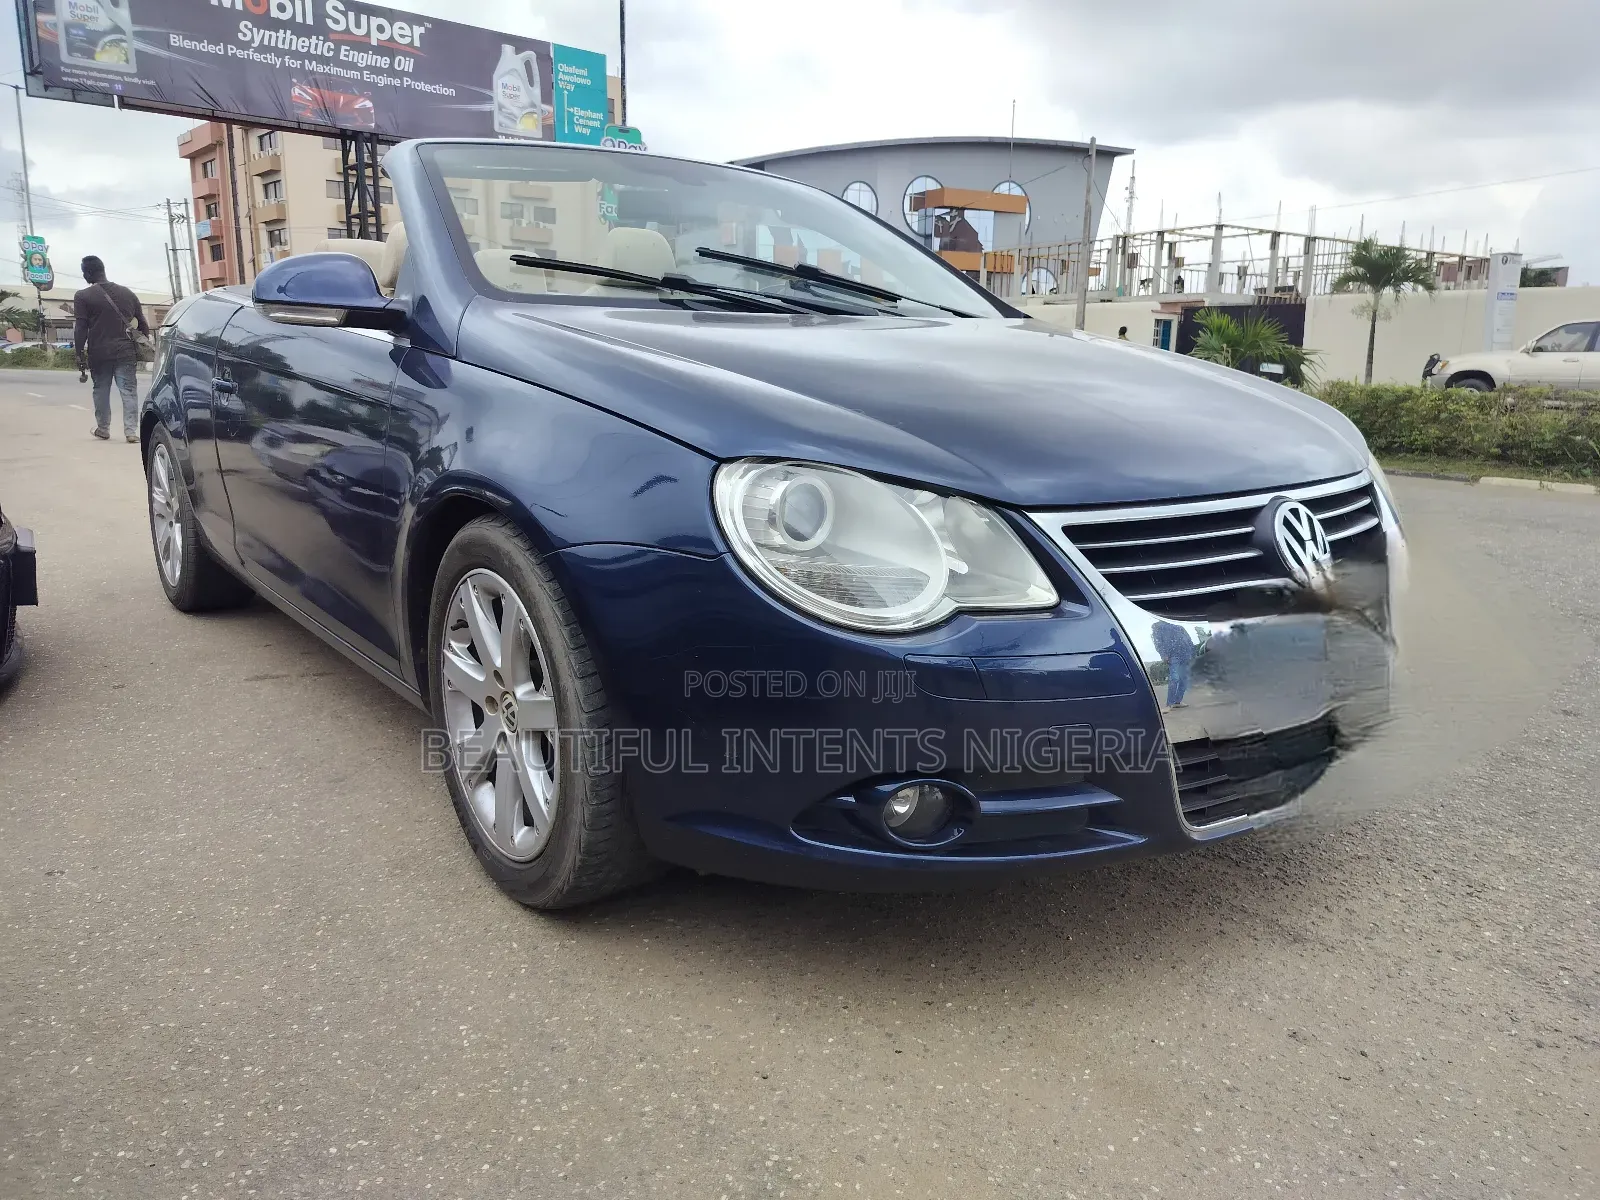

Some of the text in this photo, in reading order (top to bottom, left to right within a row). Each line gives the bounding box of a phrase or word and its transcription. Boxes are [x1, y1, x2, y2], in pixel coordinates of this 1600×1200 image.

[325, 0, 425, 47] Super
[237, 20, 415, 73] Synthetic Engine Oil
[60, 66, 71, 74] For
[72, 68, 88, 76] more
[169, 33, 456, 97] Blended Perfectly for Maximum Engine Protection
[557, 63, 588, 77] Obafemi
[557, 72, 592, 86] Awolowo
[557, 80, 575, 92] Way
[573, 106, 604, 120] Elephant
[573, 116, 601, 128] Cement
[574, 125, 591, 136] Way
[26, 271, 43, 281] Face
